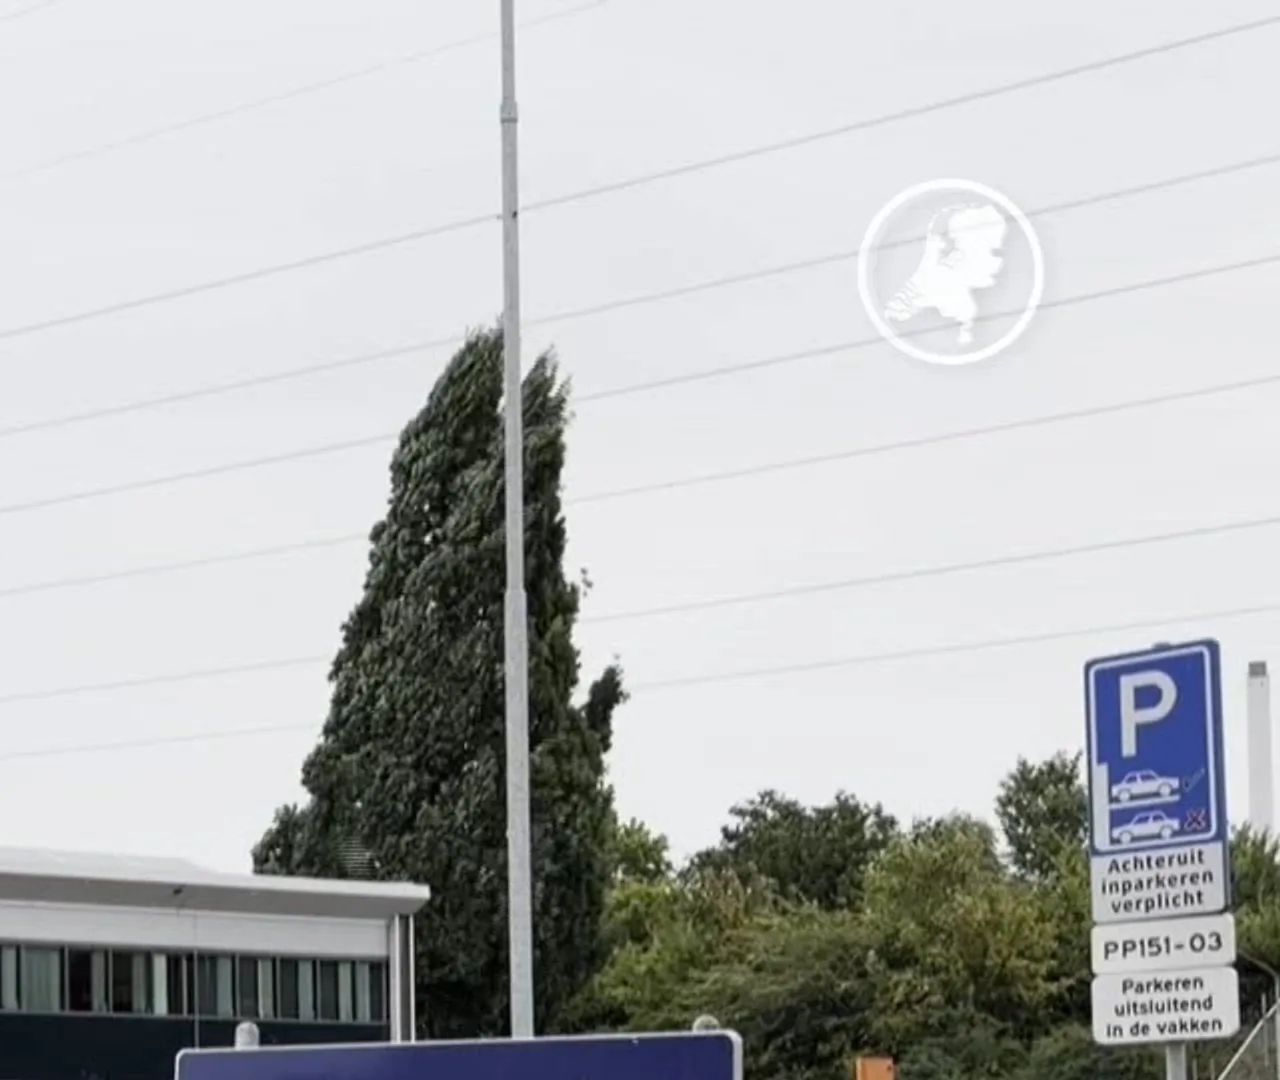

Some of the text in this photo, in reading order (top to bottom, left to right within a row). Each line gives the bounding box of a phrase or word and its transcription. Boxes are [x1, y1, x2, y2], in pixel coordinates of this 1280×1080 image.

[1119, 669, 1178, 758] P
[1108, 849, 1205, 874] Achteruit
[1102, 871, 1213, 895] inparkeren
[1111, 890, 1204, 913] verplicht
[1104, 932, 1222, 960] PP151-03
[1121, 976, 1204, 994] Parkeren
[1114, 995, 1213, 1017] uitsluitend
[1107, 1017, 1222, 1038] in de vakken
